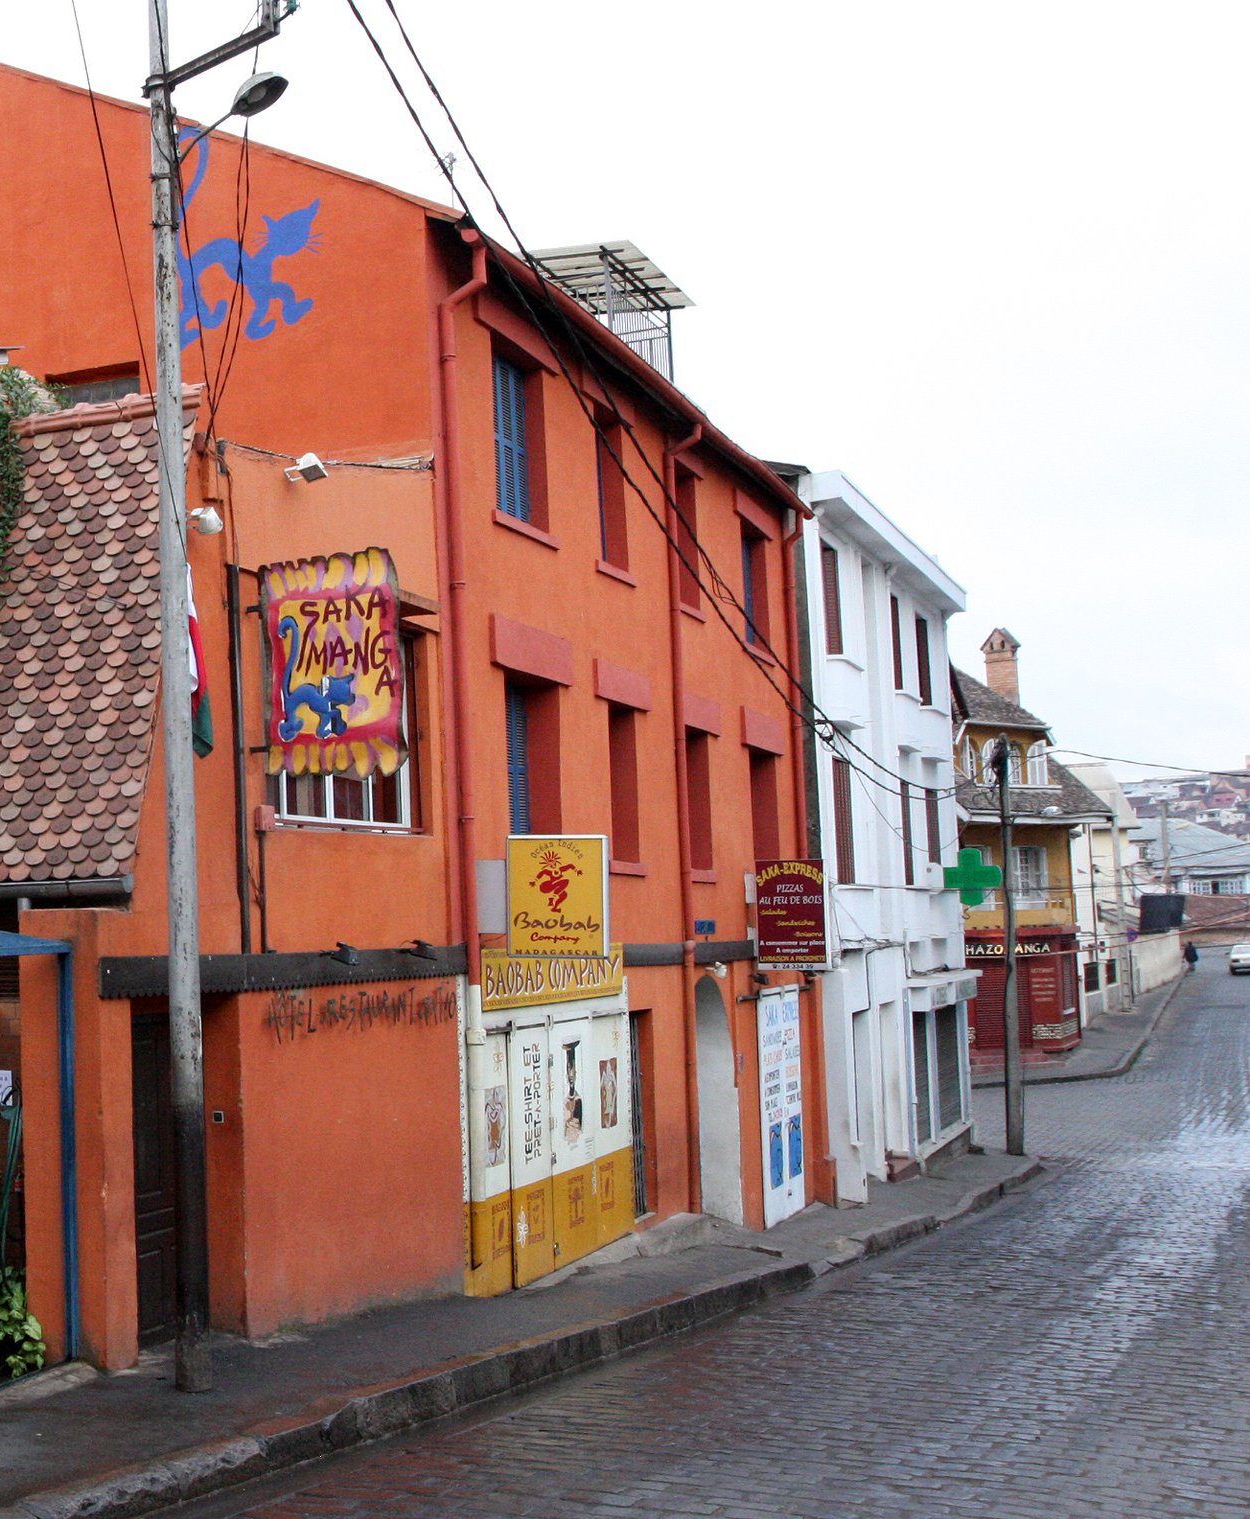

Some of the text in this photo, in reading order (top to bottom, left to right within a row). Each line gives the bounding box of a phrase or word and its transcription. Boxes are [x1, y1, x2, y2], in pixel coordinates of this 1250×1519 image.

[756, 862, 824, 887] SAKA-EXPRESS
[776, 883, 804, 893] PIZZAS
[759, 895, 823, 906] AU FEU DE BOIS
[514, 912, 600, 932] Baobab
[530, 932, 580, 944] Company
[515, 949, 598, 957] MADAGASCAR
[966, 943, 1050, 955] HAZOANGA
[485, 953, 621, 1000] BAOBAB COMPANY
[523, 1046, 533, 1165] TEE-SHIRT ET
[532, 1042, 543, 1159] PRET-A-PORTER
